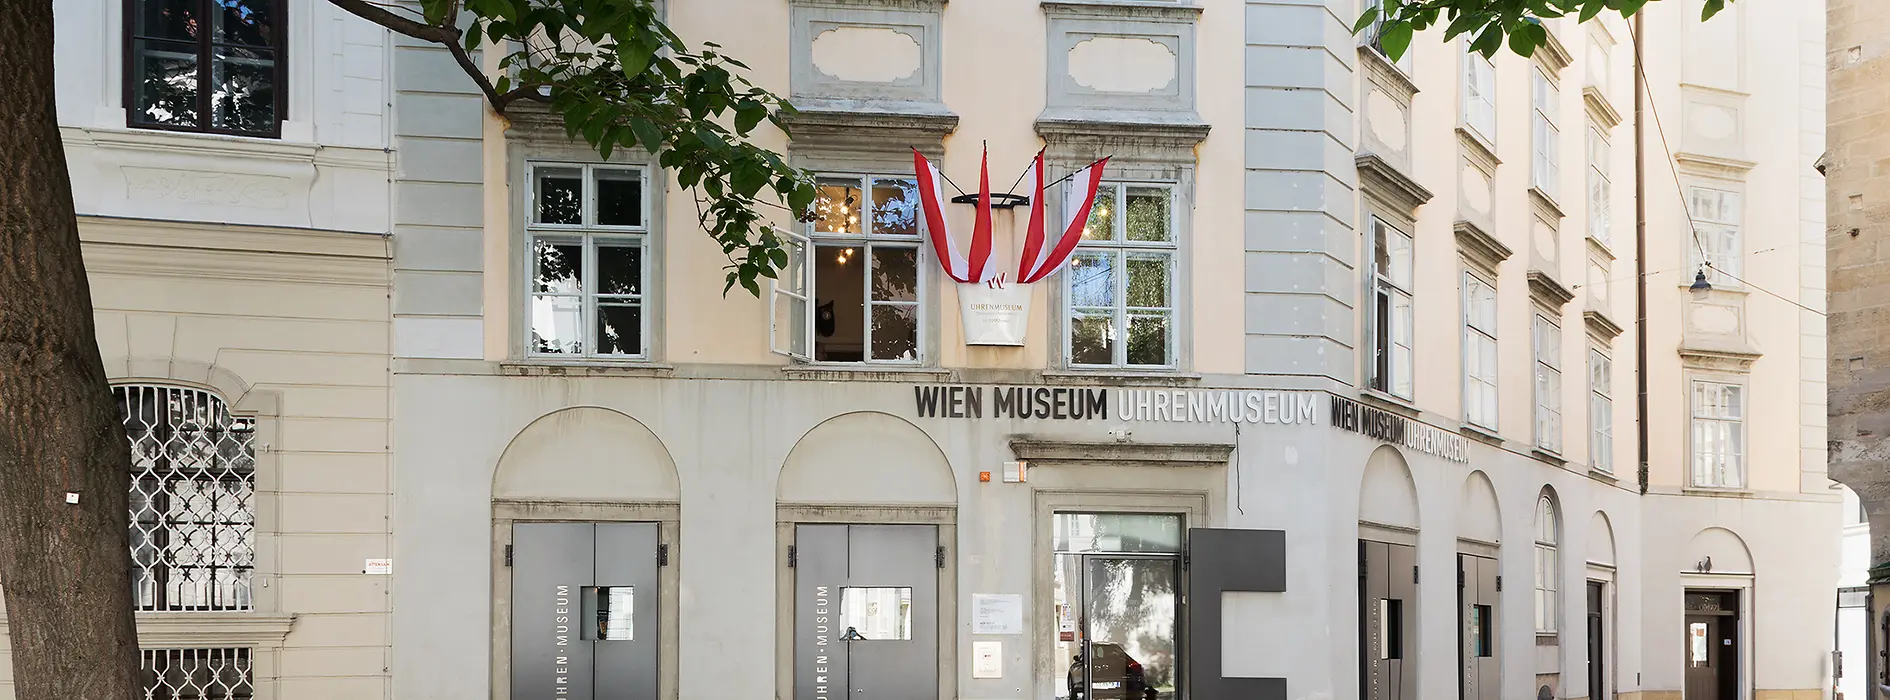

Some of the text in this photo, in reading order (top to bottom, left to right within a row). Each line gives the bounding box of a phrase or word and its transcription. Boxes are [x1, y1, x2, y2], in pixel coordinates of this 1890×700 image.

[969, 303, 1023, 311] UHRENMUSEUM
[914, 386, 1317, 425] WIEN MUSEUM UHRENMUSEUM
[1331, 395, 1470, 464] WIEN MUSEUM UHRENMUSEUM
